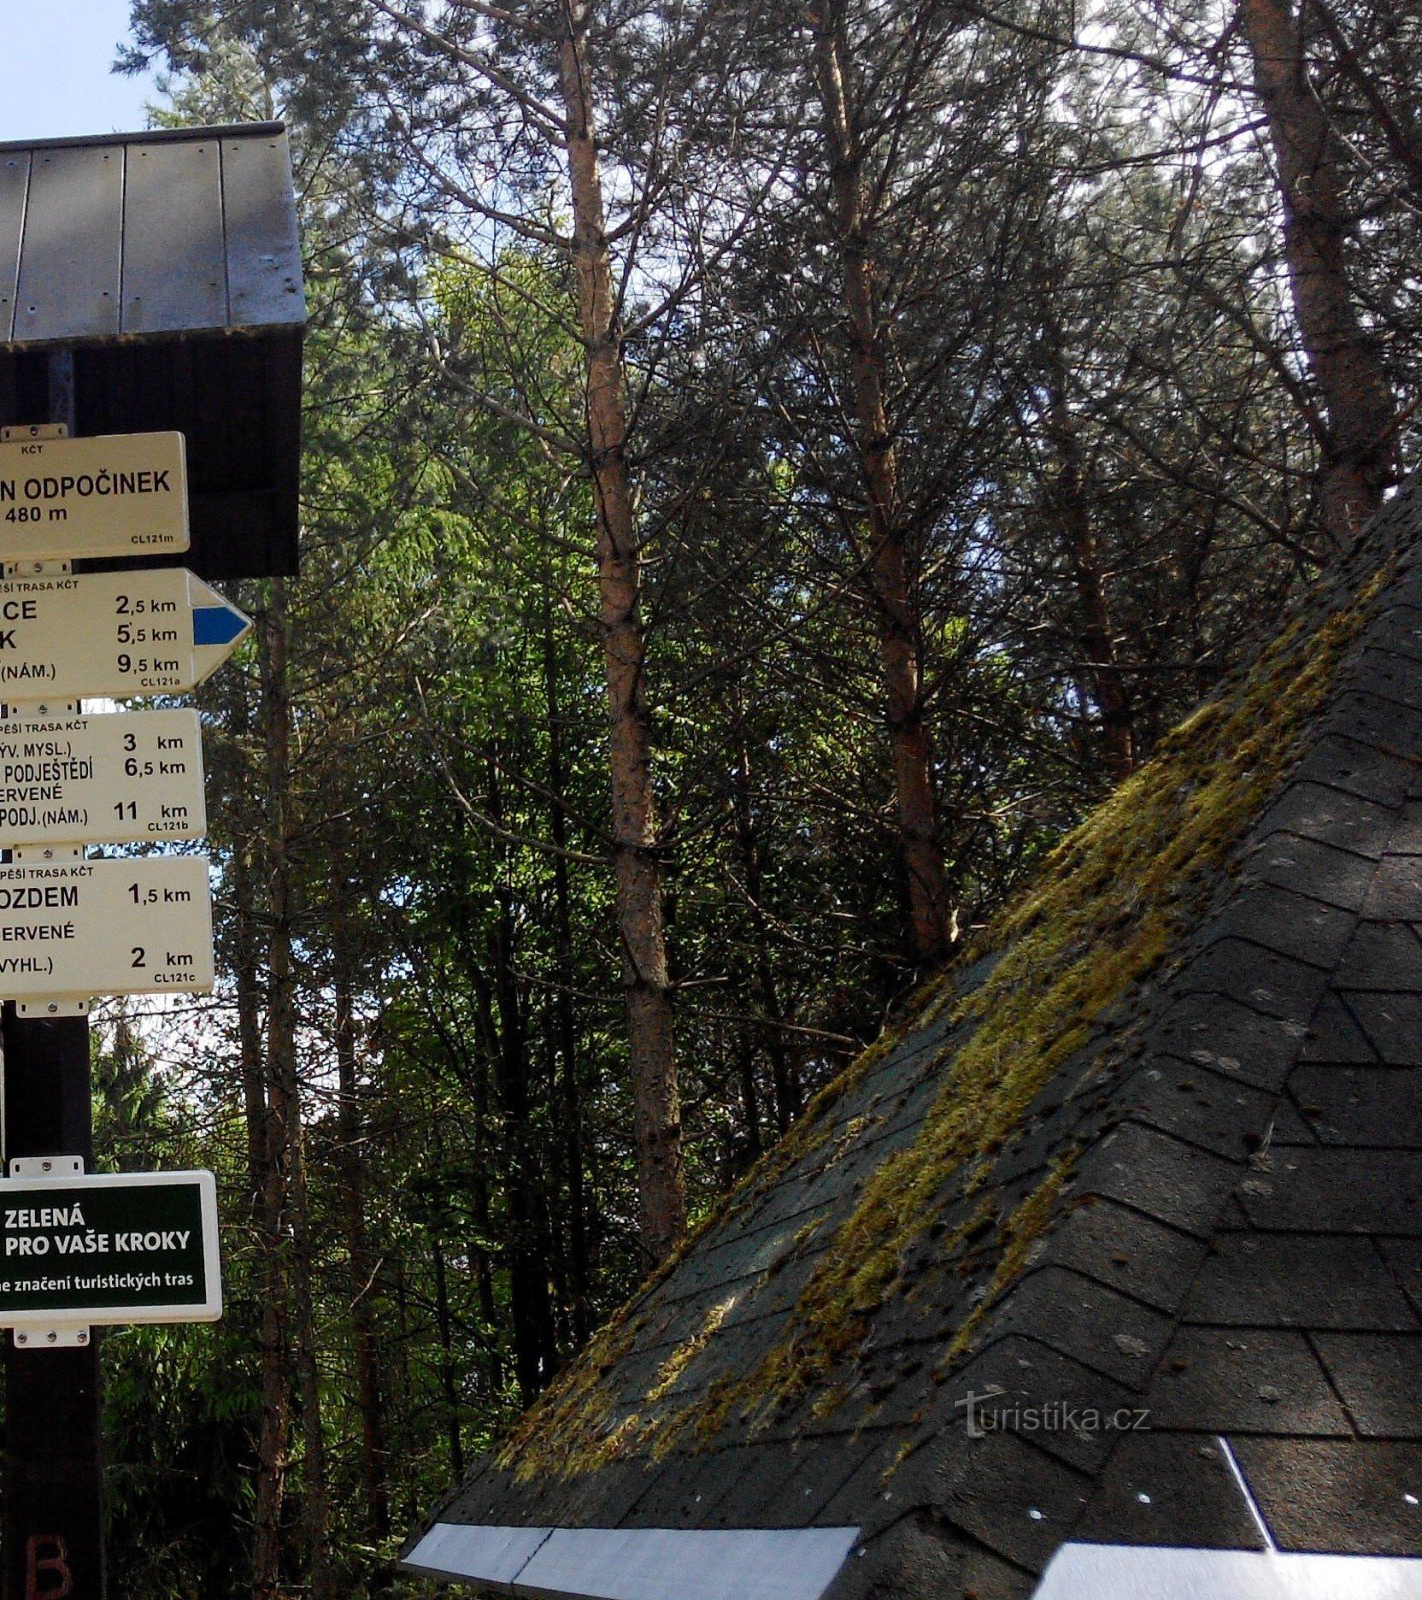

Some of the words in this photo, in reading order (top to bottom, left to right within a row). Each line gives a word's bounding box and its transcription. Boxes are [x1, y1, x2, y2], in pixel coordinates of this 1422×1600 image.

[22, 445, 43, 454] KČT
[24, 469, 170, 499] ODPOČINEK
[5, 507, 41, 523] 480
[49, 508, 67, 520] m
[131, 534, 173, 543] CL121m
[17, 582, 54, 591] TRASA
[57, 579, 78, 589] KČT
[115, 596, 144, 615] 2,5
[150, 599, 176, 613] km
[117, 624, 146, 645] 5,5
[152, 628, 177, 641] km
[117, 654, 147, 673] 9,5
[153, 658, 178, 671] km
[141, 677, 181, 687] CL121a
[25, 723, 62, 732] TRASA
[66, 720, 88, 730] KČT
[24, 742, 71, 758] MYSL.)
[123, 734, 136, 752] 3
[158, 737, 183, 749] km
[5, 756, 93, 783] PODJEŠTĚDÍ
[124, 757, 154, 778] 6,5
[160, 761, 185, 774] km
[113, 802, 138, 820] 11
[161, 805, 188, 818] km
[148, 822, 189, 831] CL121b
[29, 869, 67, 878] TRASA
[70, 866, 93, 876] KČT
[128, 883, 158, 905] 1,5
[164, 888, 191, 902] km
[131, 947, 145, 968] 2
[166, 952, 193, 965] km
[154, 973, 195, 983] CL121c
[5, 1203, 85, 1229] ZELENÁ
[5, 1237, 50, 1256] PRO
[54, 1229, 109, 1254] VAŠE
[115, 1230, 191, 1252] KROKY
[14, 1275, 71, 1292] značení
[74, 1272, 161, 1291] turistických
[165, 1272, 194, 1287] tras
